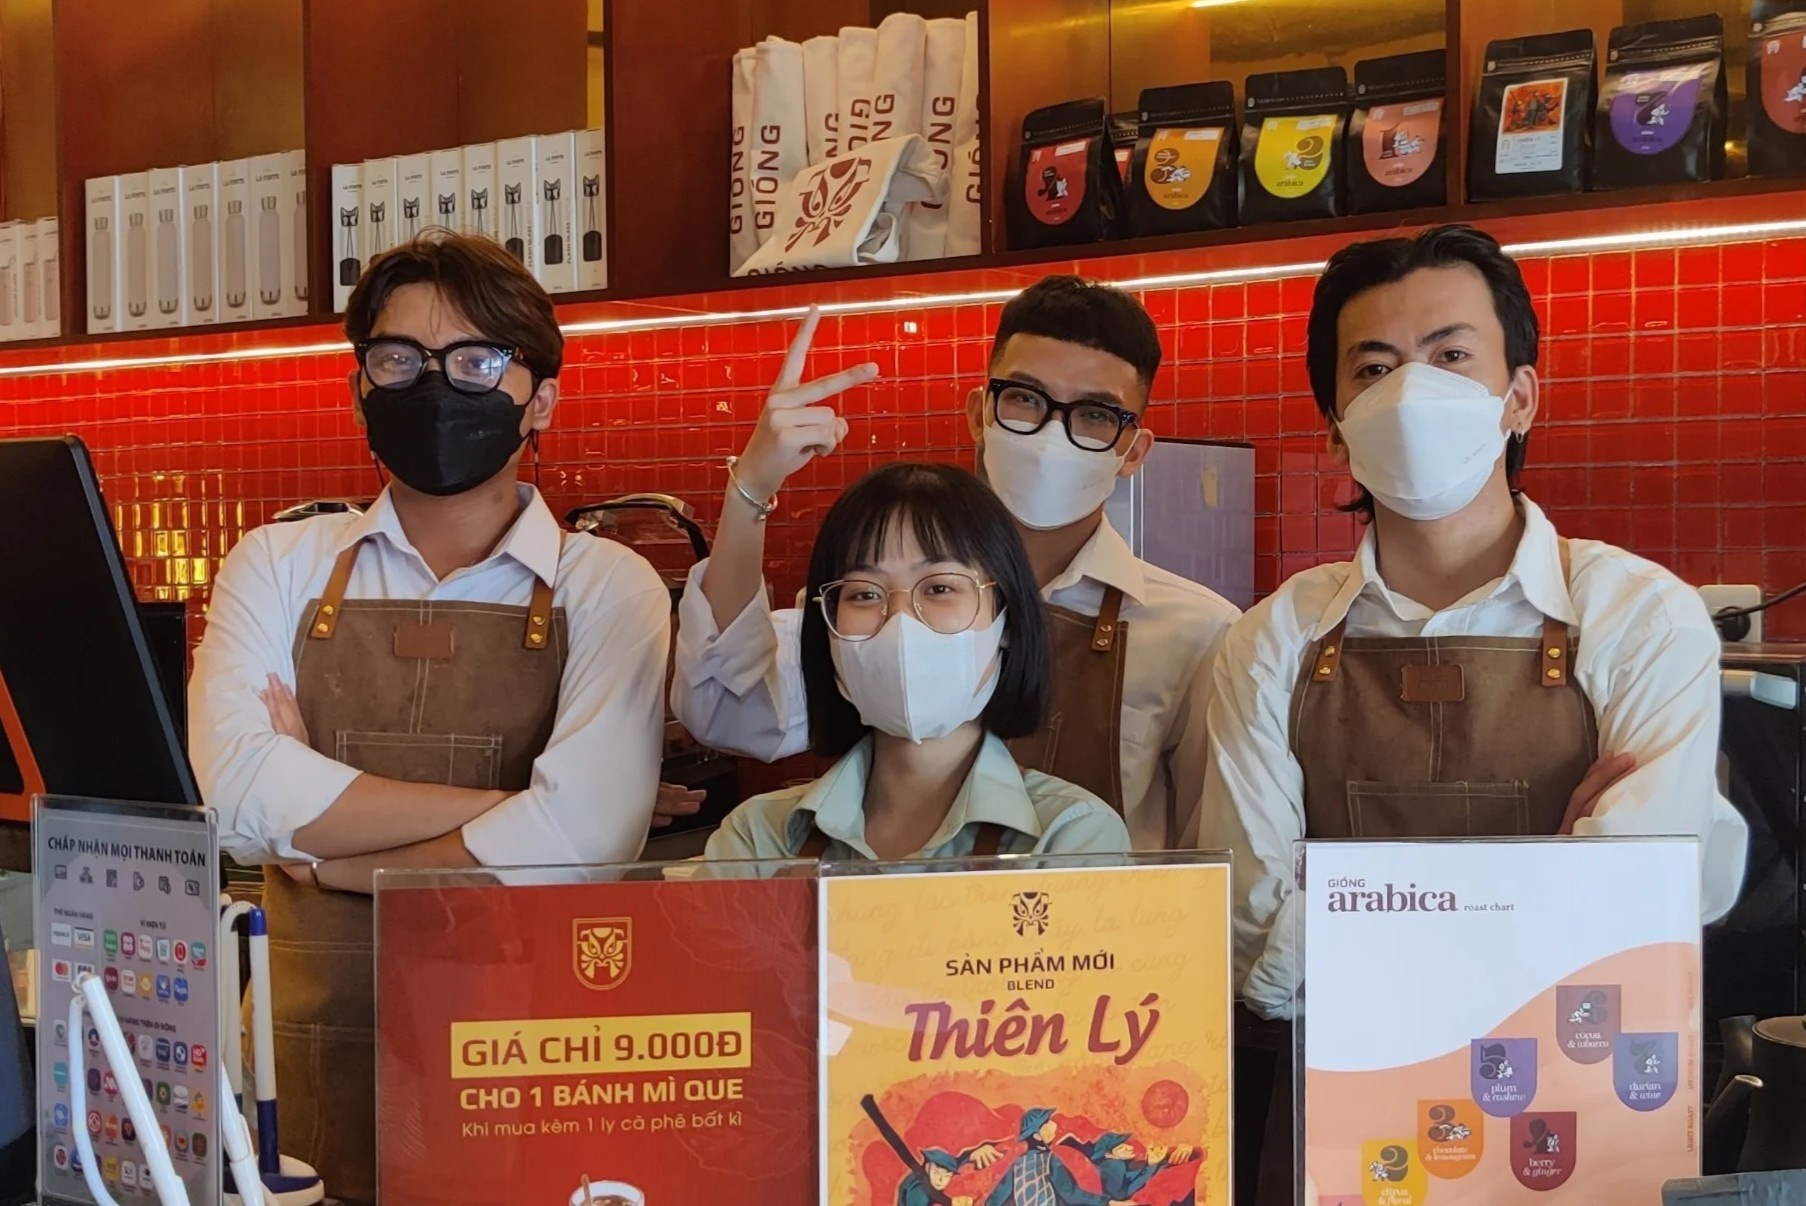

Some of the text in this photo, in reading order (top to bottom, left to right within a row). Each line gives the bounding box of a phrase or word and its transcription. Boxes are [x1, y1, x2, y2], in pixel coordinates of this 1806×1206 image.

[751, 125, 781, 229] GIÓNG
[78, 839, 108, 860] NHẬN
[110, 843, 132, 862] MỌI
[134, 845, 172, 864] THANH
[175, 848, 206, 867] TOÁN
[1328, 877, 1366, 888] GIÓNG
[1327, 883, 1515, 913] arabica roast chart
[945, 953, 992, 977] SẢN
[999, 948, 1065, 974] PHẨM
[1072, 950, 1115, 971] MỚI
[1007, 979, 1055, 991] BLEND
[904, 992, 1160, 1066] Thiên Lý
[462, 1024, 742, 1067] GIÁ CHỈ 9.000Đ
[1567, 1040, 1576, 1049] &
[1479, 1043, 1506, 1080] 5
[460, 1075, 743, 1110] CHO 1 BÁNH MÌ QUE
[1491, 1083, 1517, 1094] plum
[1629, 1082, 1661, 1091] durian
[1629, 1090, 1662, 1100] & wine
[1482, 1092, 1526, 1101] & cashew
[462, 1110, 742, 1137] Khi mua kèm 1 ly cà phê bất kì
[1529, 1157, 1555, 1168] berry
[1522, 1167, 1563, 1178] & ginger
